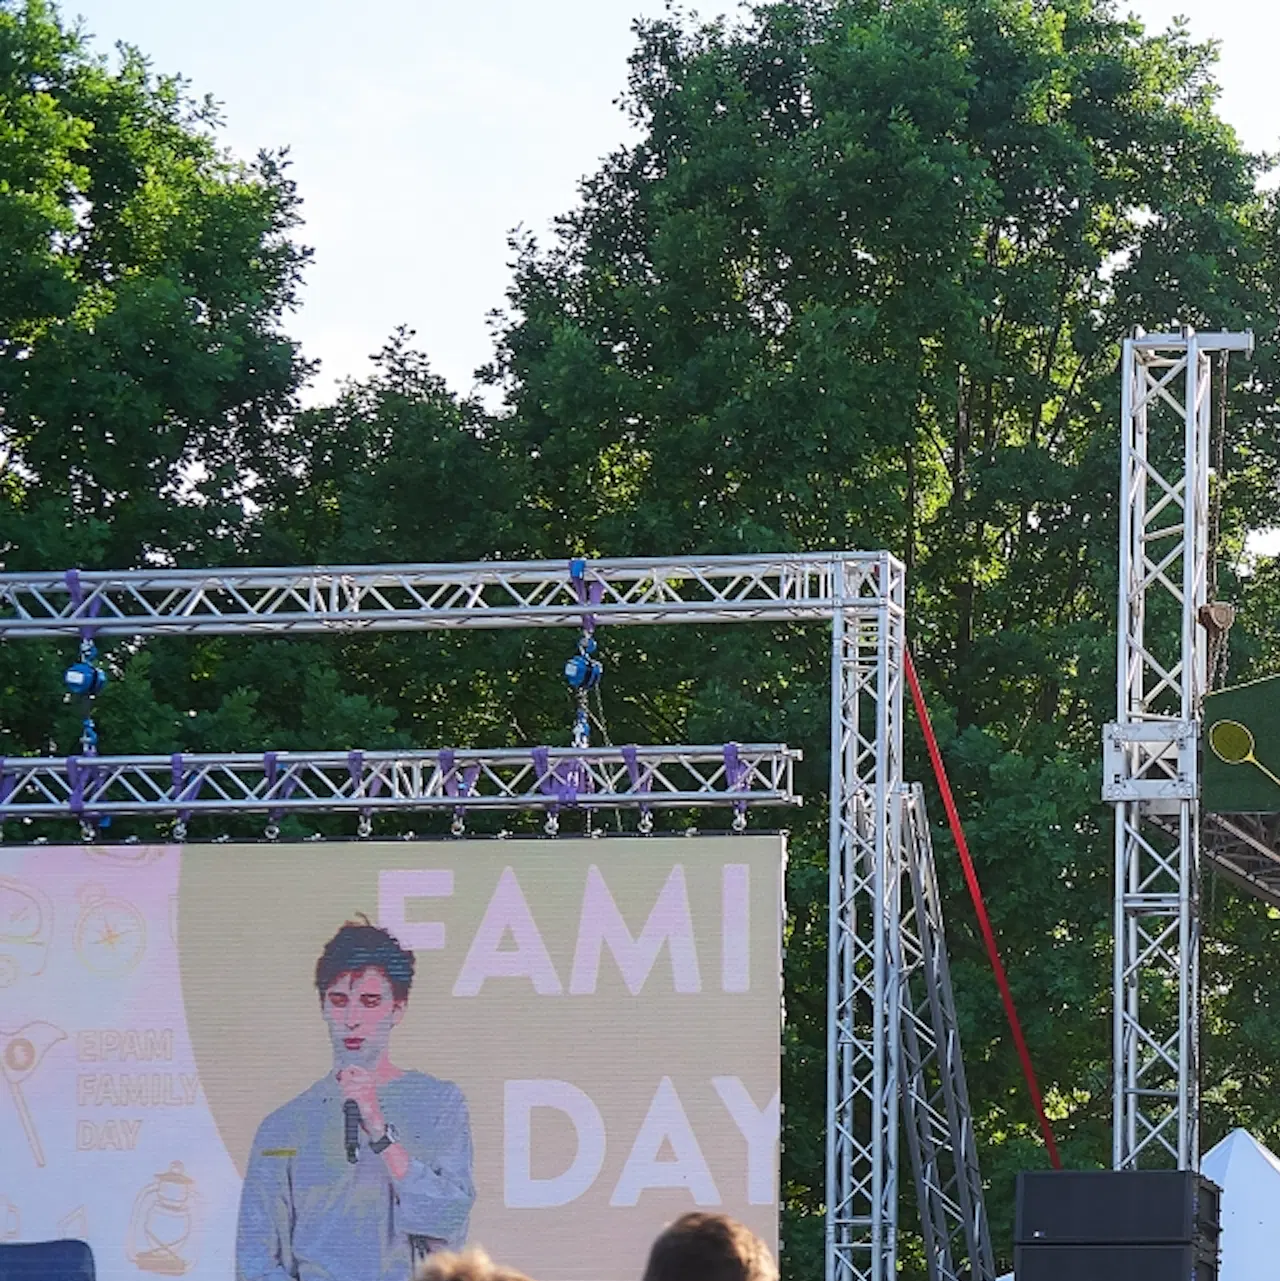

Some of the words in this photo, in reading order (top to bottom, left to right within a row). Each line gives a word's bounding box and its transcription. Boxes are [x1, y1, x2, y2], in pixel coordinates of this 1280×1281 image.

[378, 864, 750, 996] FAMI
[76, 1029, 173, 1062] EPAM
[76, 1074, 199, 1106] FAMILY
[76, 1119, 143, 1150] DAY
[504, 1075, 780, 1209] DAY
